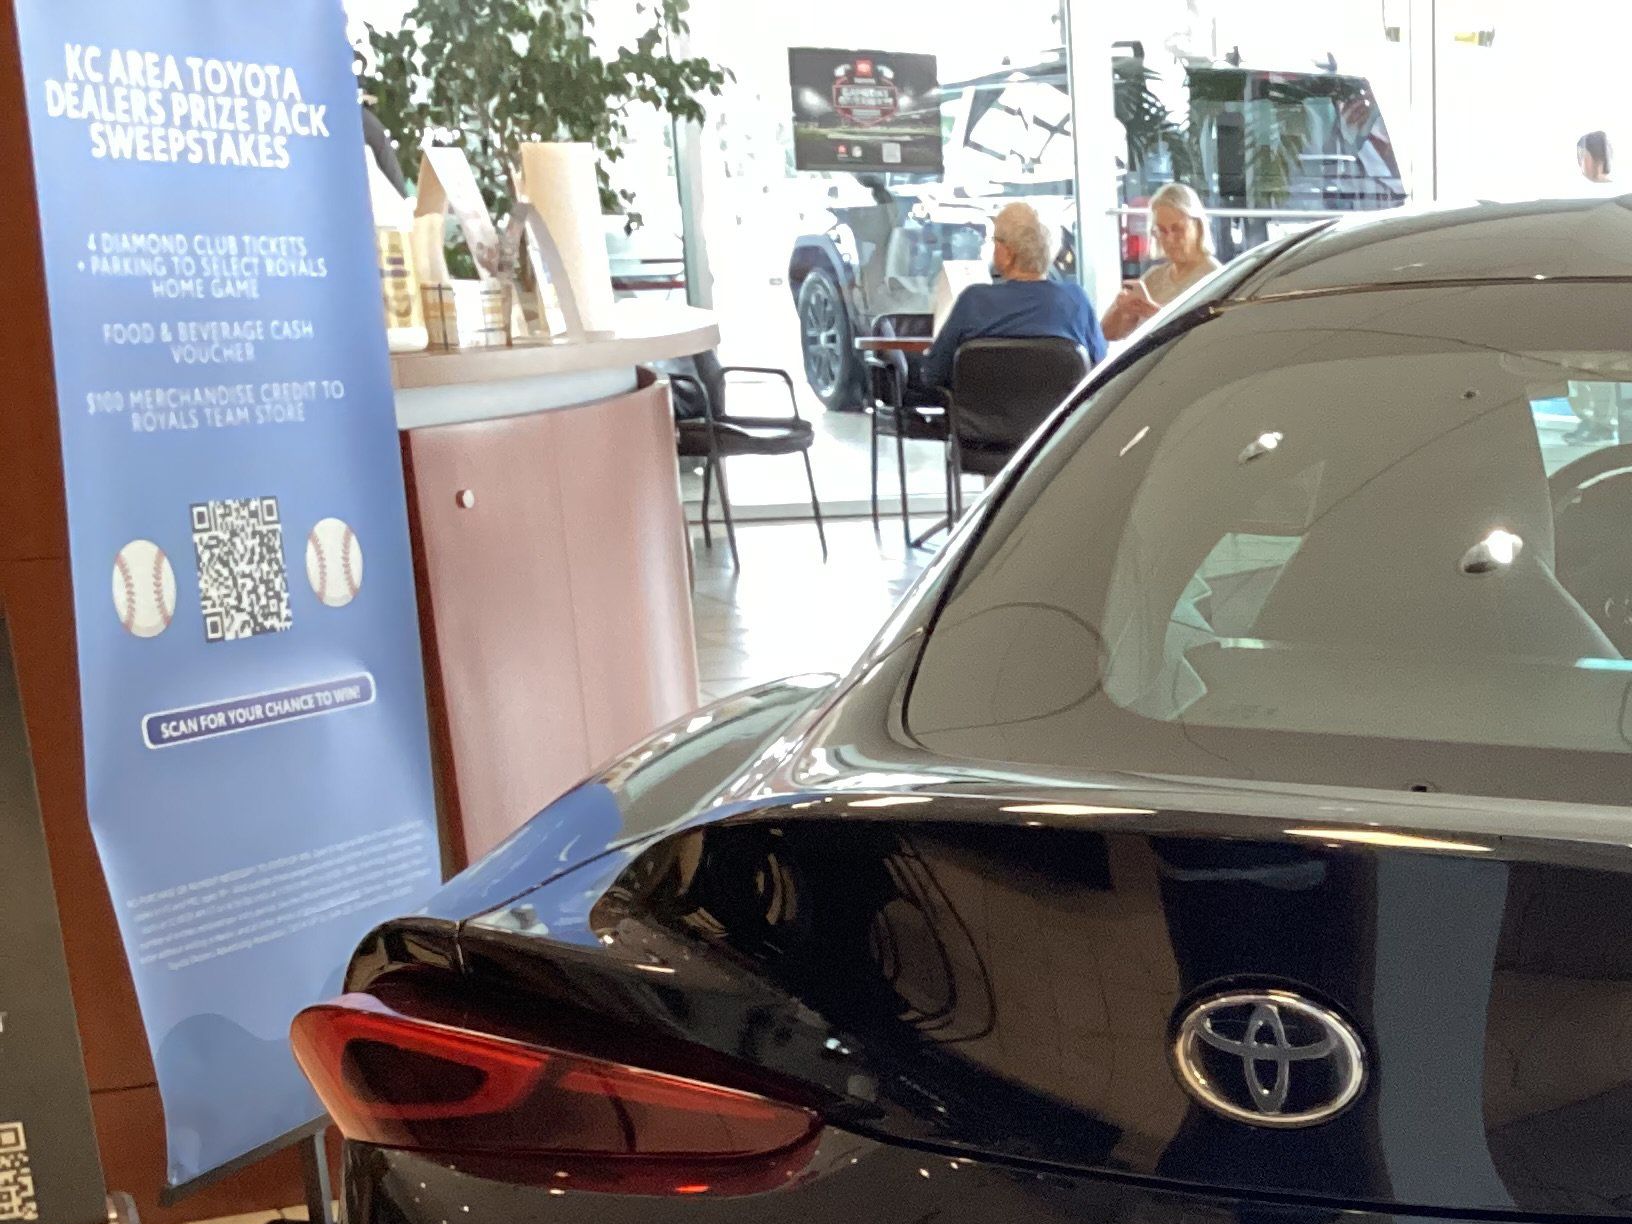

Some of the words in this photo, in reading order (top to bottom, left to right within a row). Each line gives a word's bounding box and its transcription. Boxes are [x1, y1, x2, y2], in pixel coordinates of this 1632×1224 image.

[64, 42, 103, 83] KC
[108, 48, 184, 91] AREA
[185, 56, 302, 102] TOYOTA
[44, 79, 166, 126] DEALERS
[170, 92, 250, 131] PRIZE
[255, 99, 330, 138] PACK
[90, 122, 290, 169] SWEEPSTAKES
[101, 233, 188, 255] DIAMOND
[193, 234, 238, 256] CLUB
[241, 235, 307, 257] TICKETS
[91, 255, 167, 277] PARKING
[172, 256, 195, 276] TO
[201, 256, 259, 277] SELECT
[265, 257, 328, 277] ROYALS
[152, 278, 205, 299] HOME
[211, 279, 260, 299] GAME
[103, 322, 154, 345] FOOD
[160, 322, 172, 342] &
[177, 320, 265, 343] BEVERAGE
[270, 320, 314, 341] CASH
[171, 342, 255, 364] VOUCHER
[129, 383, 254, 409] MERCHANDISE
[260, 381, 316, 403] CREDIT
[321, 380, 345, 400] TO
[131, 409, 199, 432] ROYALS
[204, 407, 250, 428] TEAM
[256, 402, 305, 425] STORE
[160, 717, 198, 739] SCAN
[200, 712, 226, 731] FOR
[227, 705, 264, 724] YOUR
[265, 694, 315, 718] CHANCE
[316, 691, 333, 708] TO
[333, 685, 361, 704] WIN!
